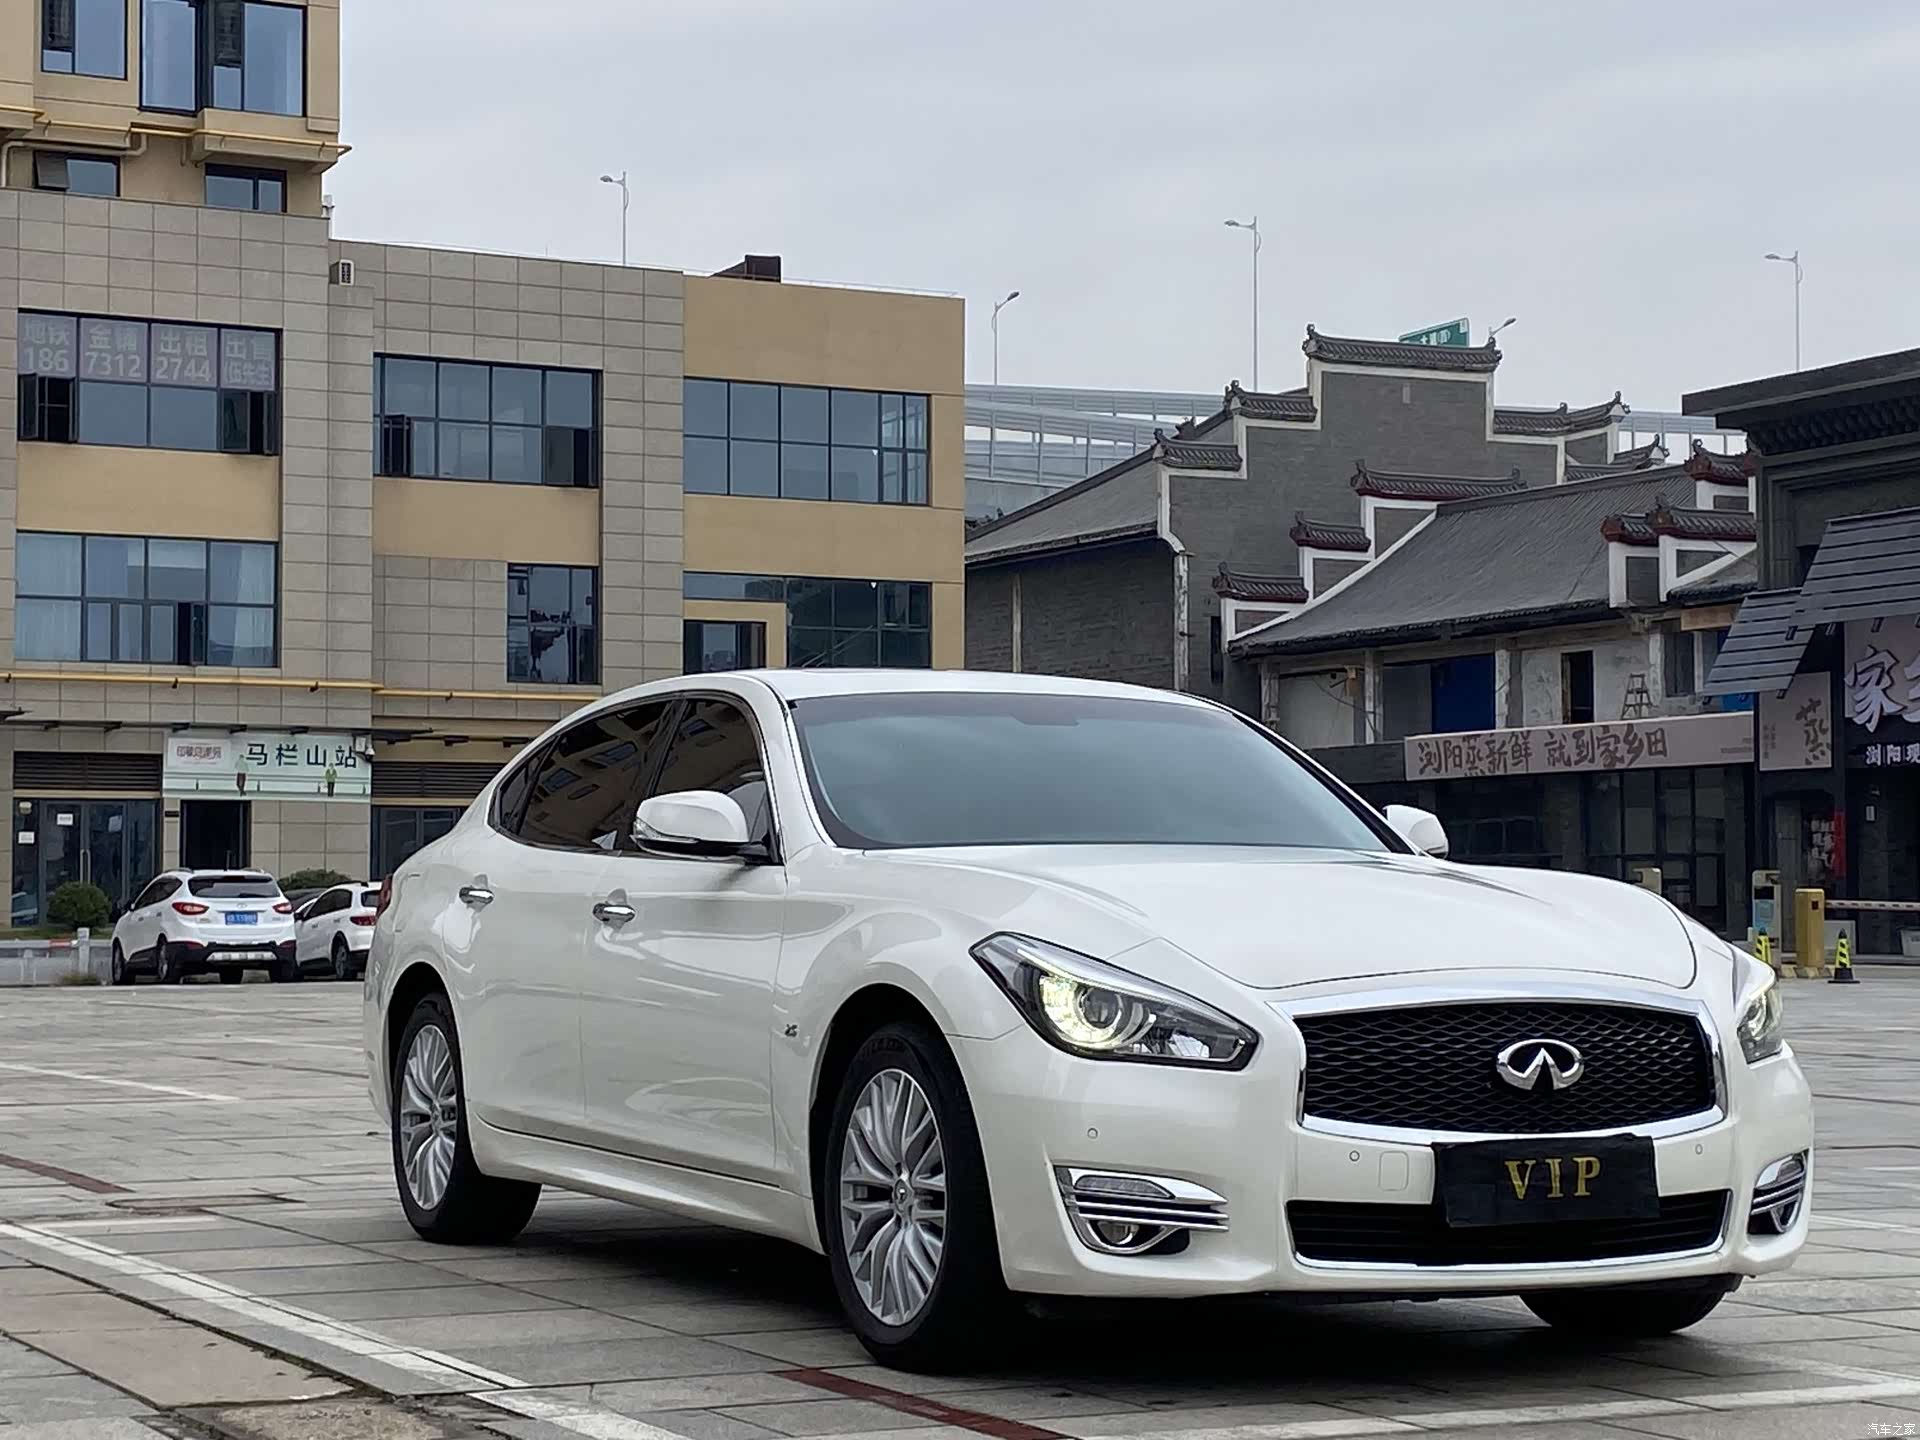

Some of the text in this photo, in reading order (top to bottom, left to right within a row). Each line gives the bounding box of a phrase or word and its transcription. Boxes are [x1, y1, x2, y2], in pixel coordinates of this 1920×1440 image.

[24, 347, 70, 372] 186
[84, 351, 142, 378] 7312
[155, 356, 212, 382] 2744
[1844, 644, 1920, 733] 家
[246, 743, 356, 768] 马栏山站
[1504, 1156, 1601, 1200] VIP
